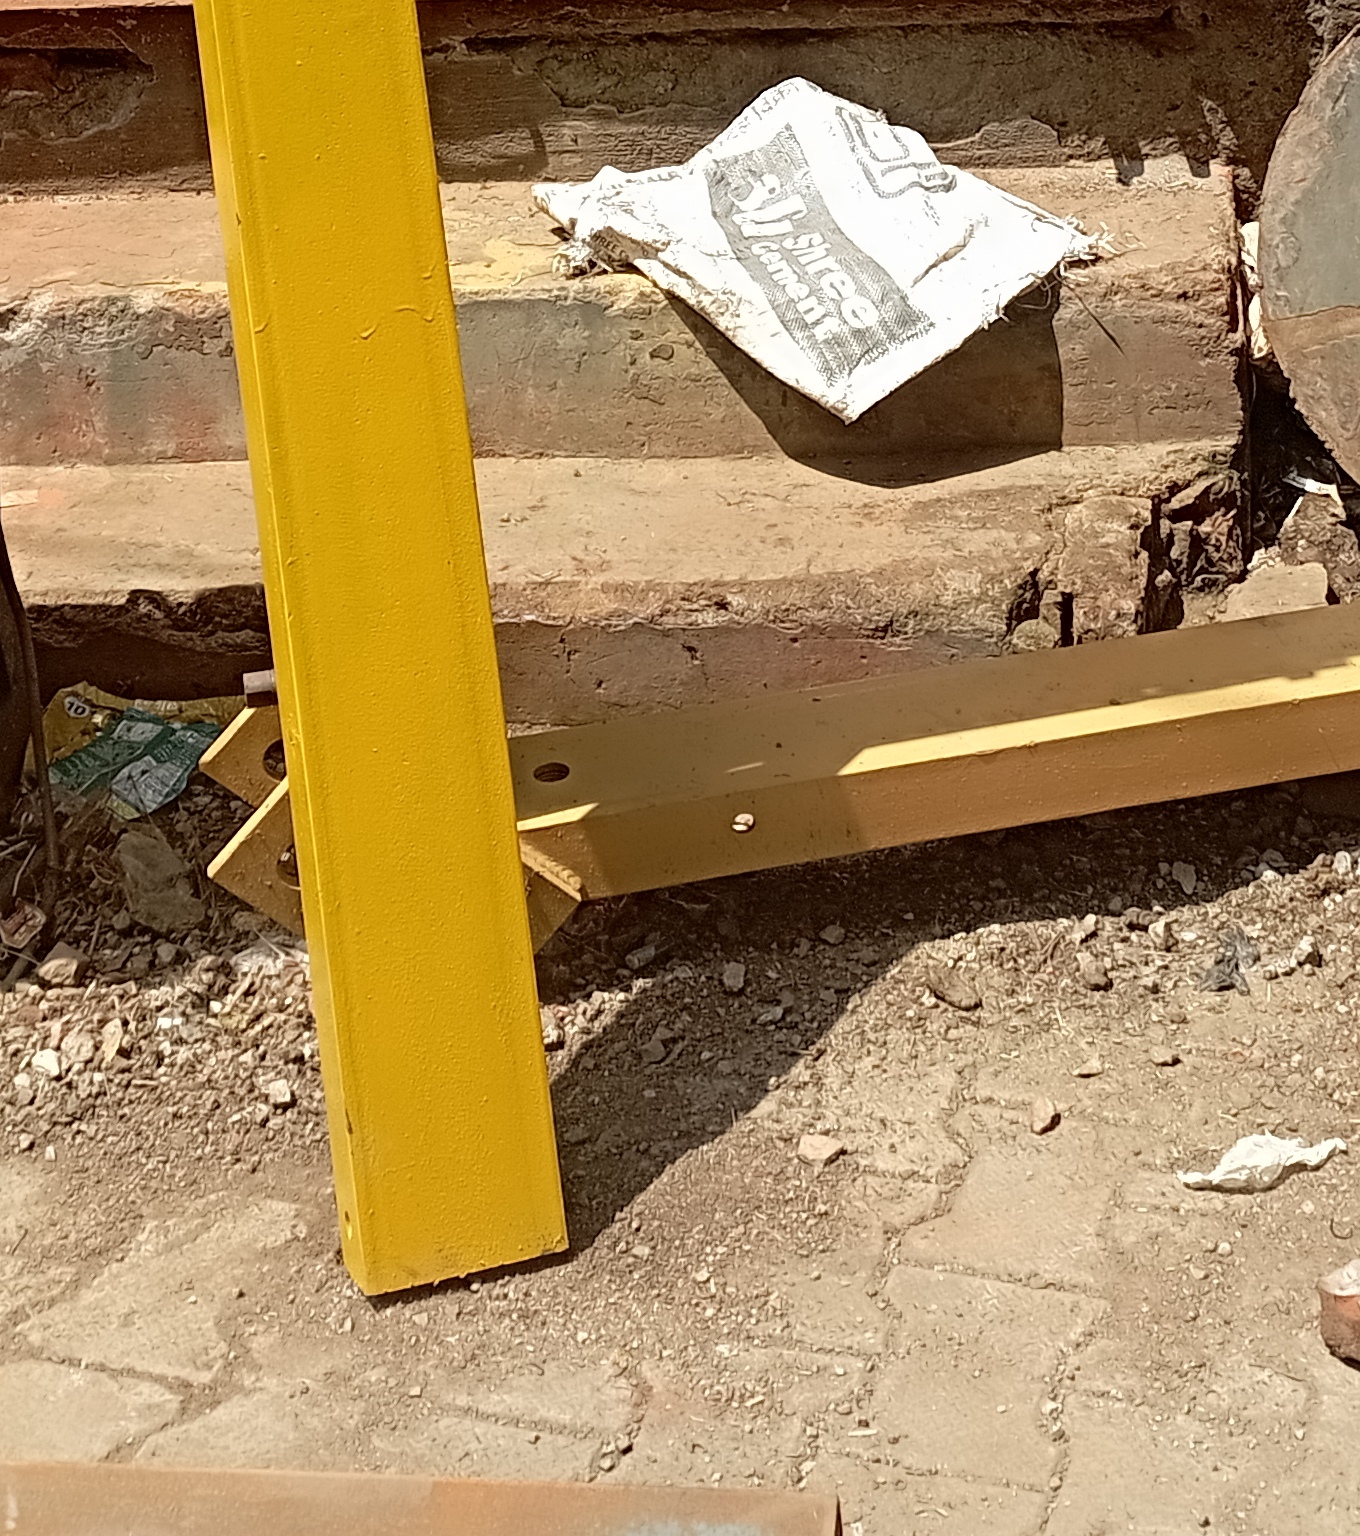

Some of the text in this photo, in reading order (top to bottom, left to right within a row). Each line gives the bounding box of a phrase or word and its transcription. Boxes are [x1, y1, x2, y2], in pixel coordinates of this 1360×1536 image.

[750, 241, 841, 341] cement
[781, 231, 880, 329] Shree
[66, 699, 88, 716] 10
